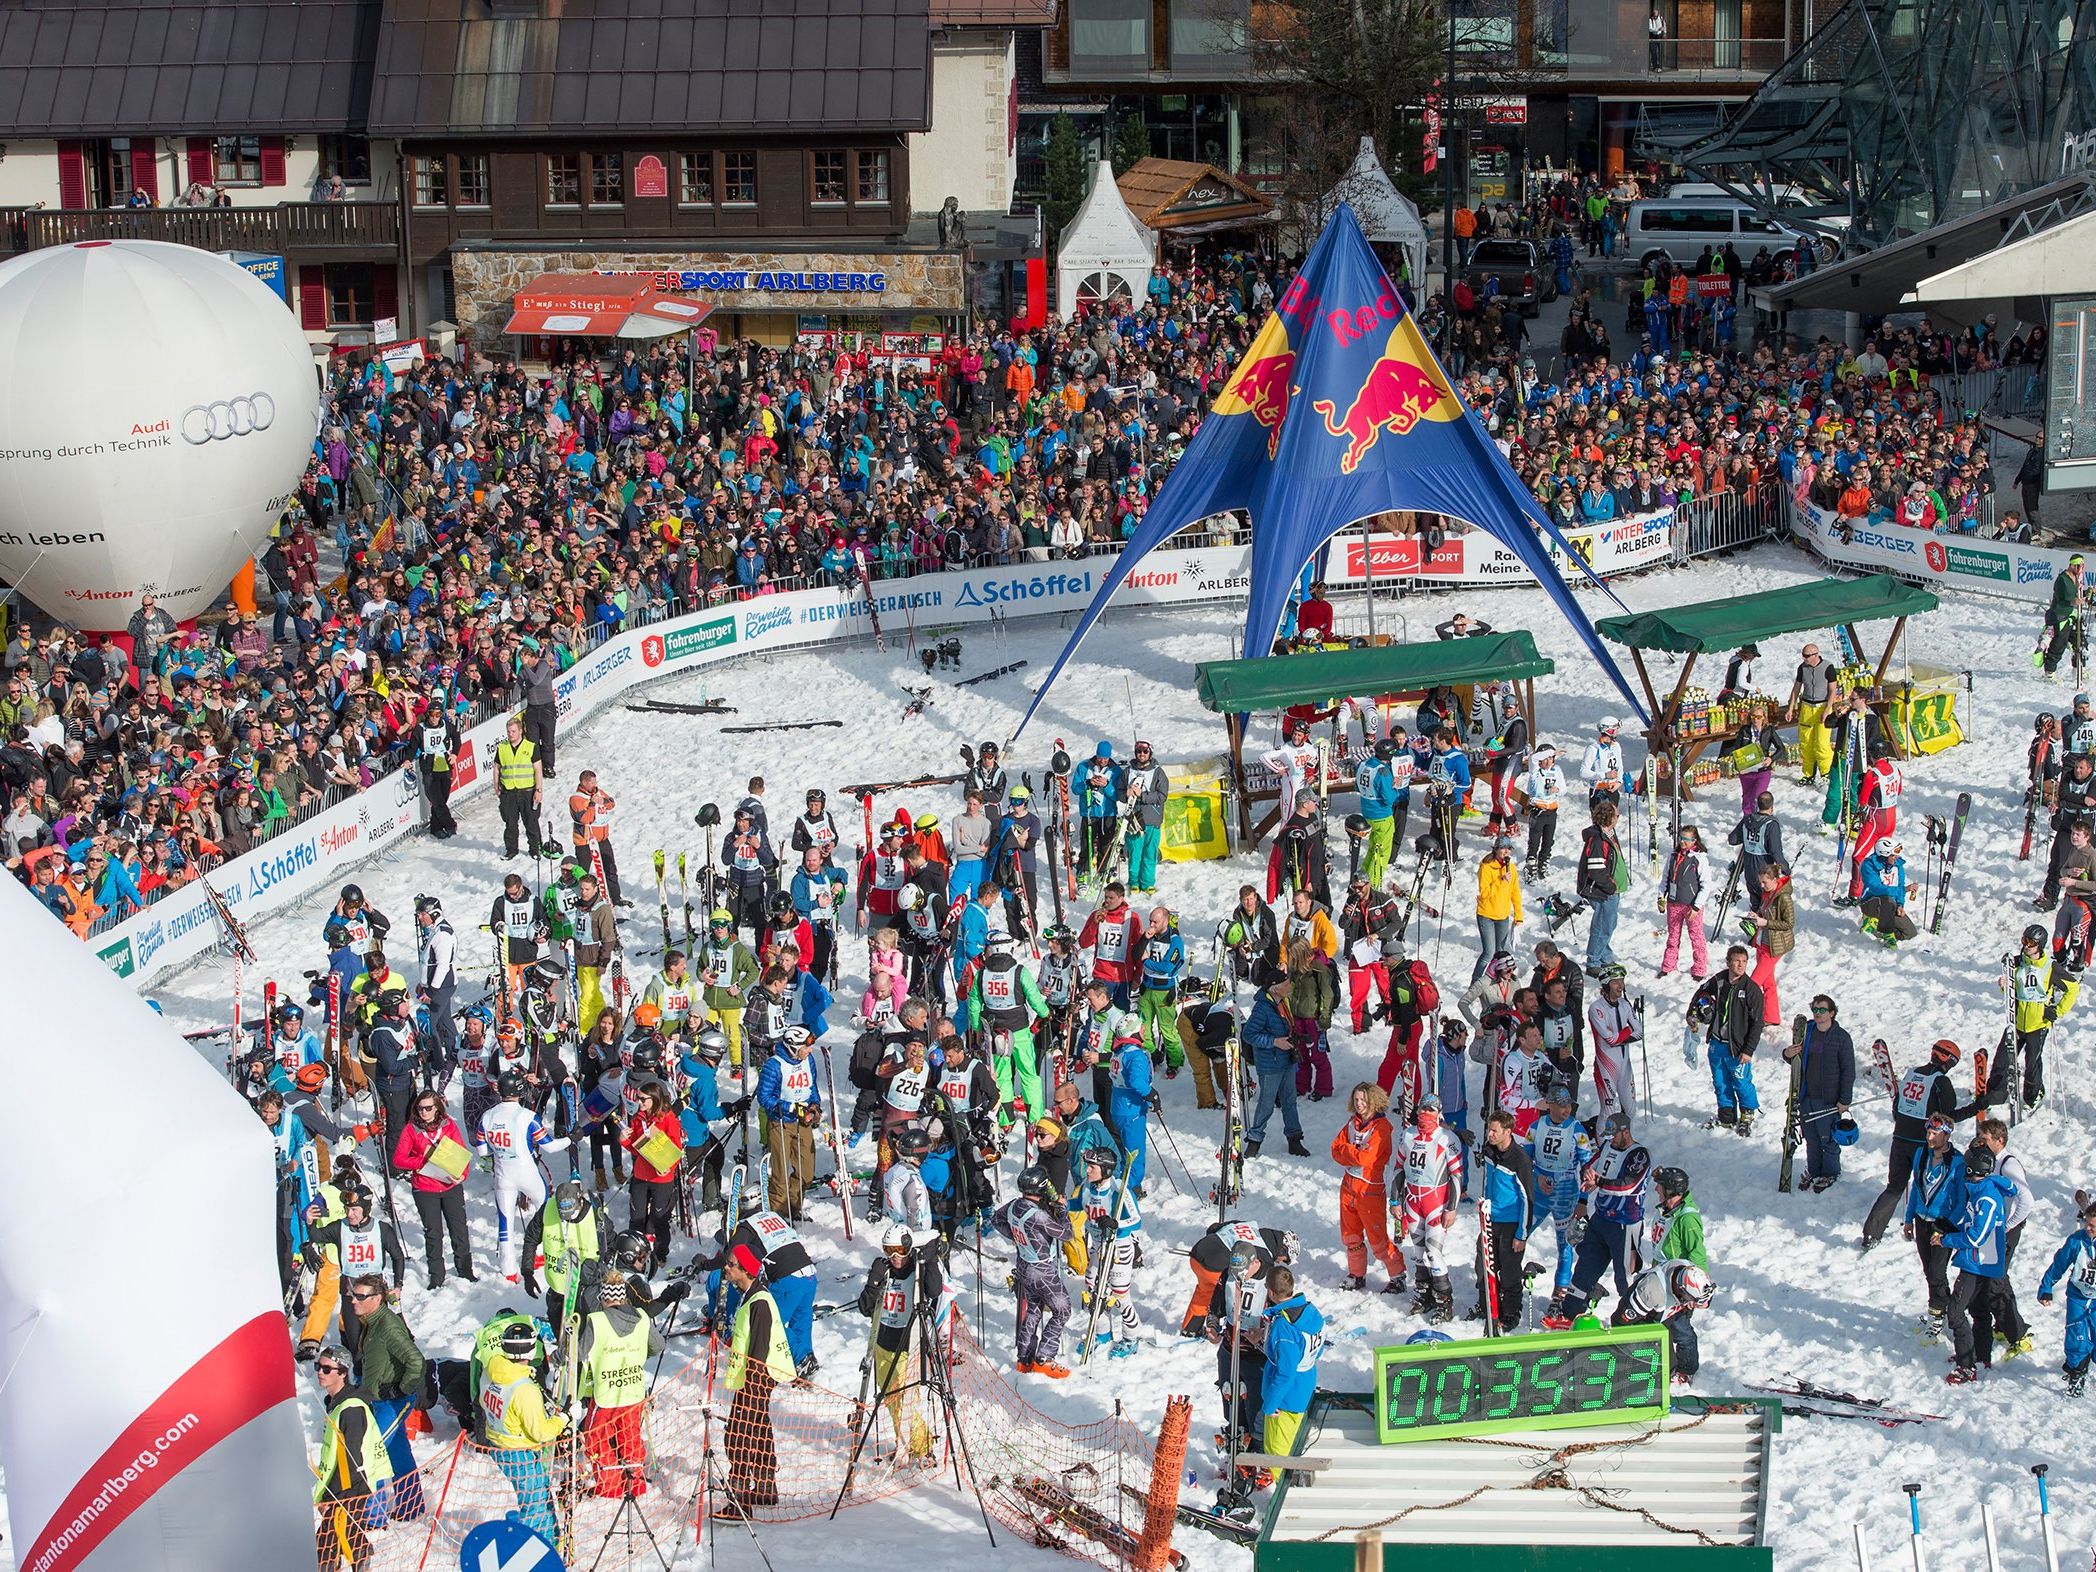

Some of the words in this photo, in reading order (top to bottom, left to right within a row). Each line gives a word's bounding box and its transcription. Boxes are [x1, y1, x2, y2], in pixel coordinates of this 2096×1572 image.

[1188, 187, 1219, 199] hex
[246, 261, 279, 273] OFFICE
[756, 271, 885, 291] ARLBERG
[1698, 281, 1730, 290] TOILETTEN
[569, 299, 605, 312] Stiegl
[1327, 277, 1400, 348] Red
[131, 420, 170, 436] Audi
[0, 449, 52, 461] sprung
[57, 443, 104, 458] durch
[109, 435, 172, 453] Technik
[1613, 514, 1673, 542] INTERSPORT
[29, 531, 105, 546] leben
[1615, 533, 1661, 555] ARLBERG
[1430, 552, 1460, 563] PORT
[1479, 563, 1521, 574] Meine
[983, 571, 1092, 604] Schöffel
[1123, 568, 1179, 590] Anton
[1198, 577, 1252, 591] ARLBER
[152, 585, 203, 600] ARLBERG
[758, 606, 790, 623] weisse
[667, 622, 733, 650] fohrenburger
[745, 617, 793, 641] Rausch
[582, 646, 633, 691] ARLBERGER
[2077, 729, 2093, 741] 149
[457, 755, 474, 773] SPORT
[327, 823, 358, 855] Anton
[368, 817, 395, 843] ARLBERG
[261, 837, 318, 890] Schöffel
[884, 865, 896, 877] 32
[592, 849, 609, 902] ATOMIC
[511, 912, 528, 926] 119
[1103, 932, 1122, 947] 123
[987, 981, 1009, 996] 356
[2024, 974, 2038, 988] 10
[328, 973, 341, 1039] ATOMIC
[667, 995, 689, 1010] 398
[1556, 1026, 1564, 1042] 3
[462, 1059, 484, 1073] 245
[787, 1072, 809, 1089] 443
[896, 1078, 920, 1097] 226
[941, 1083, 967, 1099] 460
[1902, 1082, 1925, 1101] 252
[1543, 1137, 1562, 1155] 82
[1409, 1151, 1426, 1169] 84
[304, 1150, 319, 1199] HEAD
[757, 1217, 785, 1234] 380
[1486, 1213, 1497, 1275] ATOMIC
[348, 1244, 375, 1263] 334
[2078, 1267, 2096, 1287] 18
[600, 1364, 643, 1381] STRECKEN
[608, 1374, 642, 1389] POSTEN
[1388, 1347, 1660, 1425] 00:35:33
[483, 1390, 504, 1420] 405
[32, 1411, 200, 1572] stantonamarlberg.com
